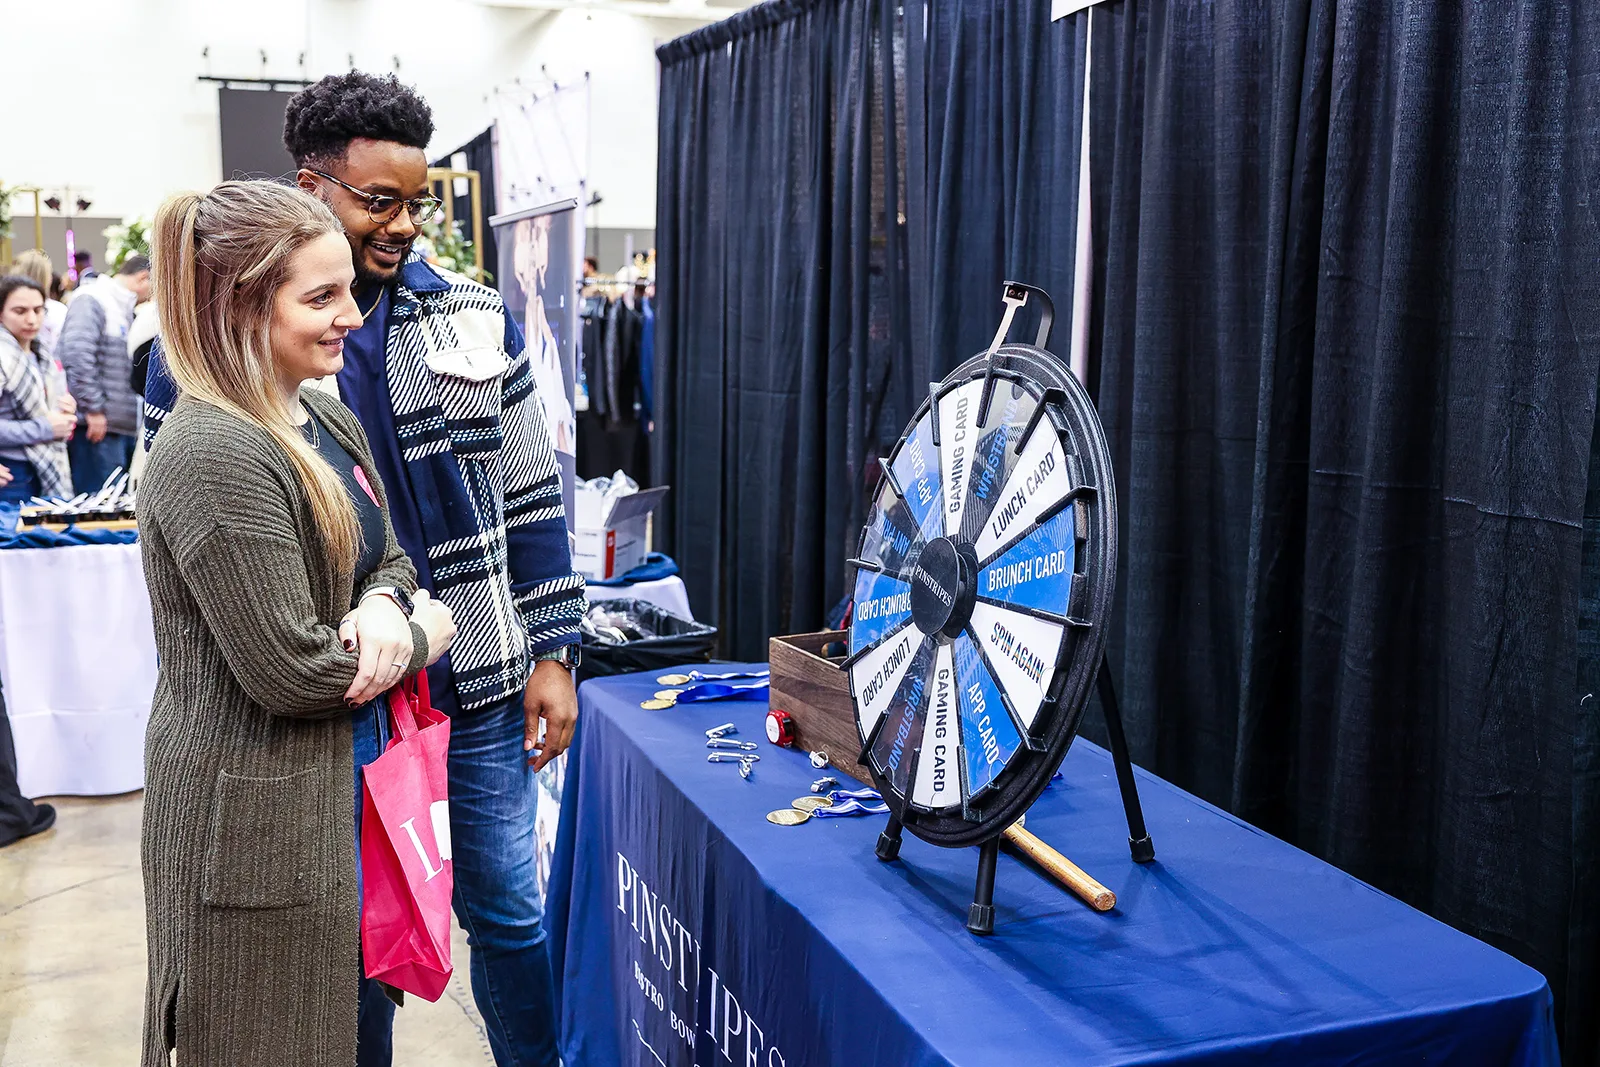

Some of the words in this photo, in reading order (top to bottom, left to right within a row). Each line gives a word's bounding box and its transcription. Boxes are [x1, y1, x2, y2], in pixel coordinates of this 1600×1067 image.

[955, 397, 968, 443] CARD
[910, 438, 925, 478] CARD
[975, 399, 1018, 499] WRISTBAND
[917, 477, 932, 507] APP
[949, 446, 965, 513] GAMING
[992, 487, 1027, 539] LUNCH
[1026, 452, 1055, 496] CARD
[892, 530, 910, 556] ANY
[915, 564, 952, 607] PINSTRIPES
[988, 559, 1033, 592] BRUNCH
[1035, 550, 1065, 579] CARD
[858, 599, 879, 621] CARD
[883, 636, 911, 682] LUNCH
[990, 621, 1015, 657] SPIN
[1011, 642, 1044, 684] AGAIN
[862, 670, 884, 707] CARD
[935, 668, 949, 739] GAMING
[888, 678, 924, 771] WRISTBAND
[968, 681, 986, 716] APP
[978, 715, 1000, 765] CARD
[933, 745, 947, 792] CARD
[617, 852, 785, 1067] PINSTIPE
